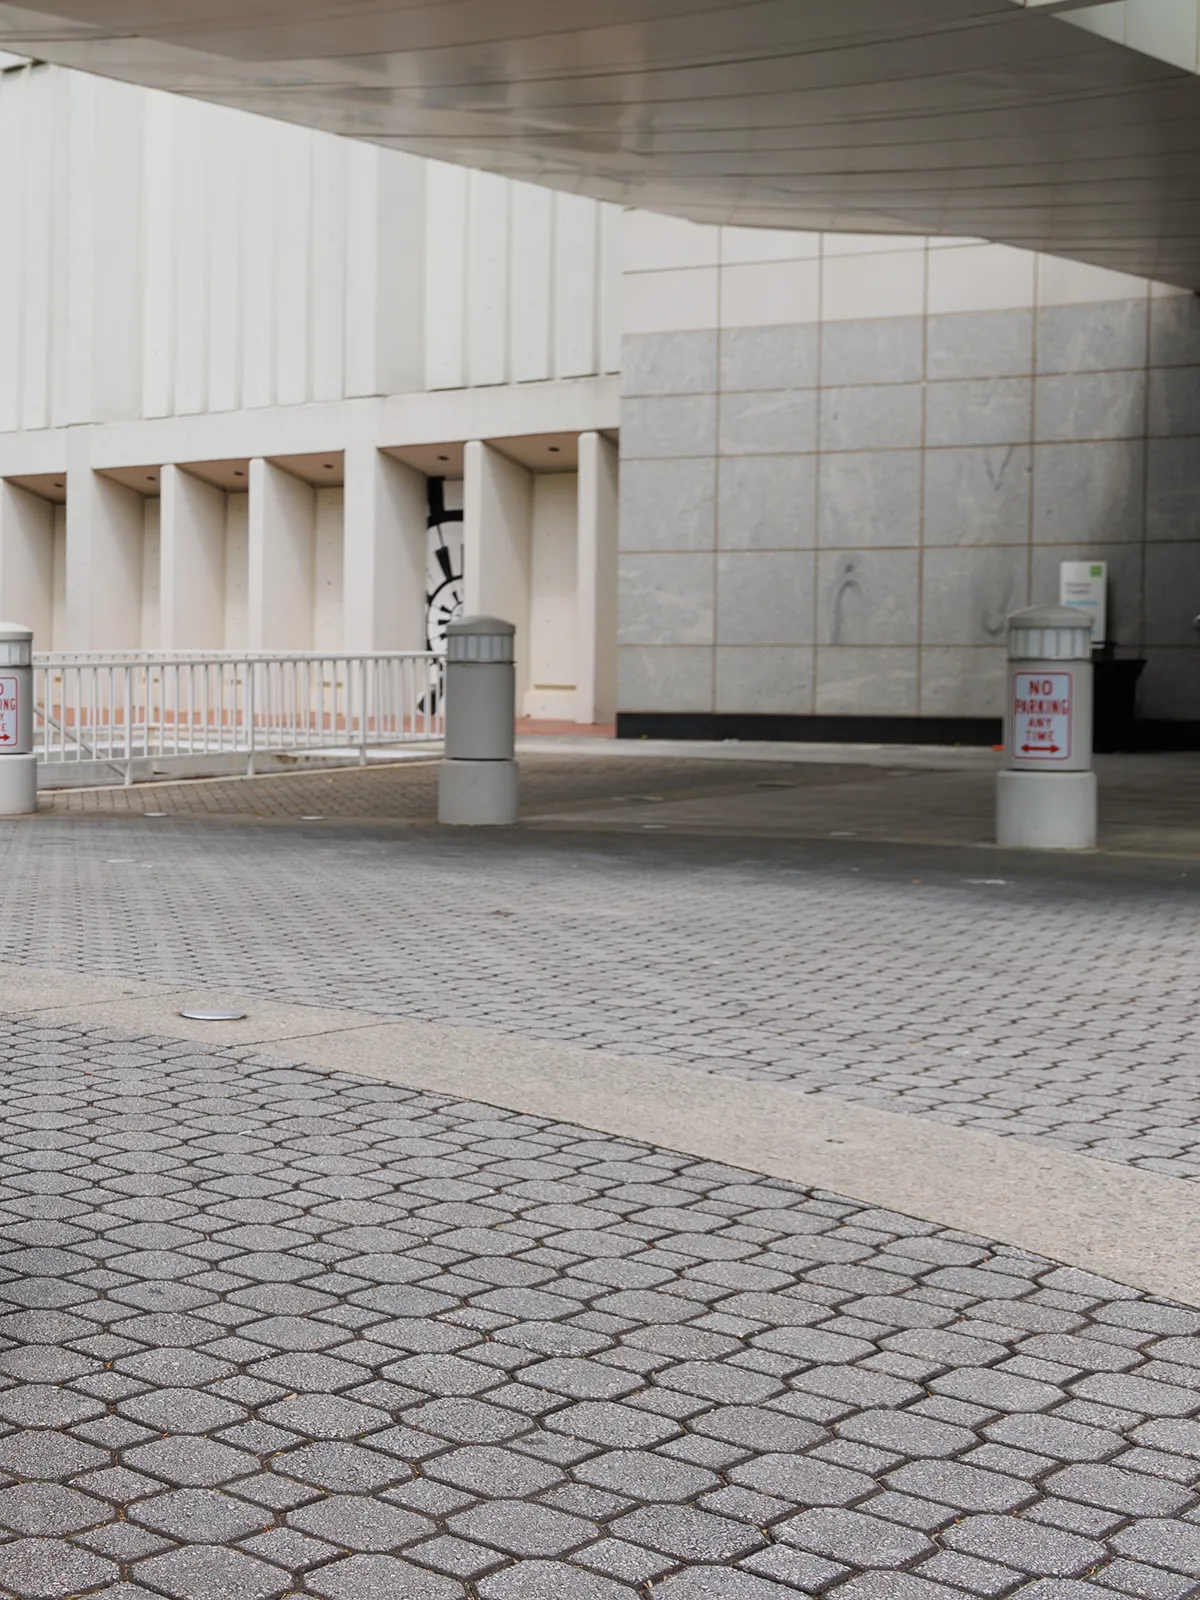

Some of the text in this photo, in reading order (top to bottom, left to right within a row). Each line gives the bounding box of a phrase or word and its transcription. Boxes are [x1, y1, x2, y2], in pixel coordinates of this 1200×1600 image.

[1029, 680, 1053, 696] NO
[1014, 699, 1070, 715] PARKING
[1028, 718, 1052, 728] ANY
[1025, 730, 1055, 742] TIME
